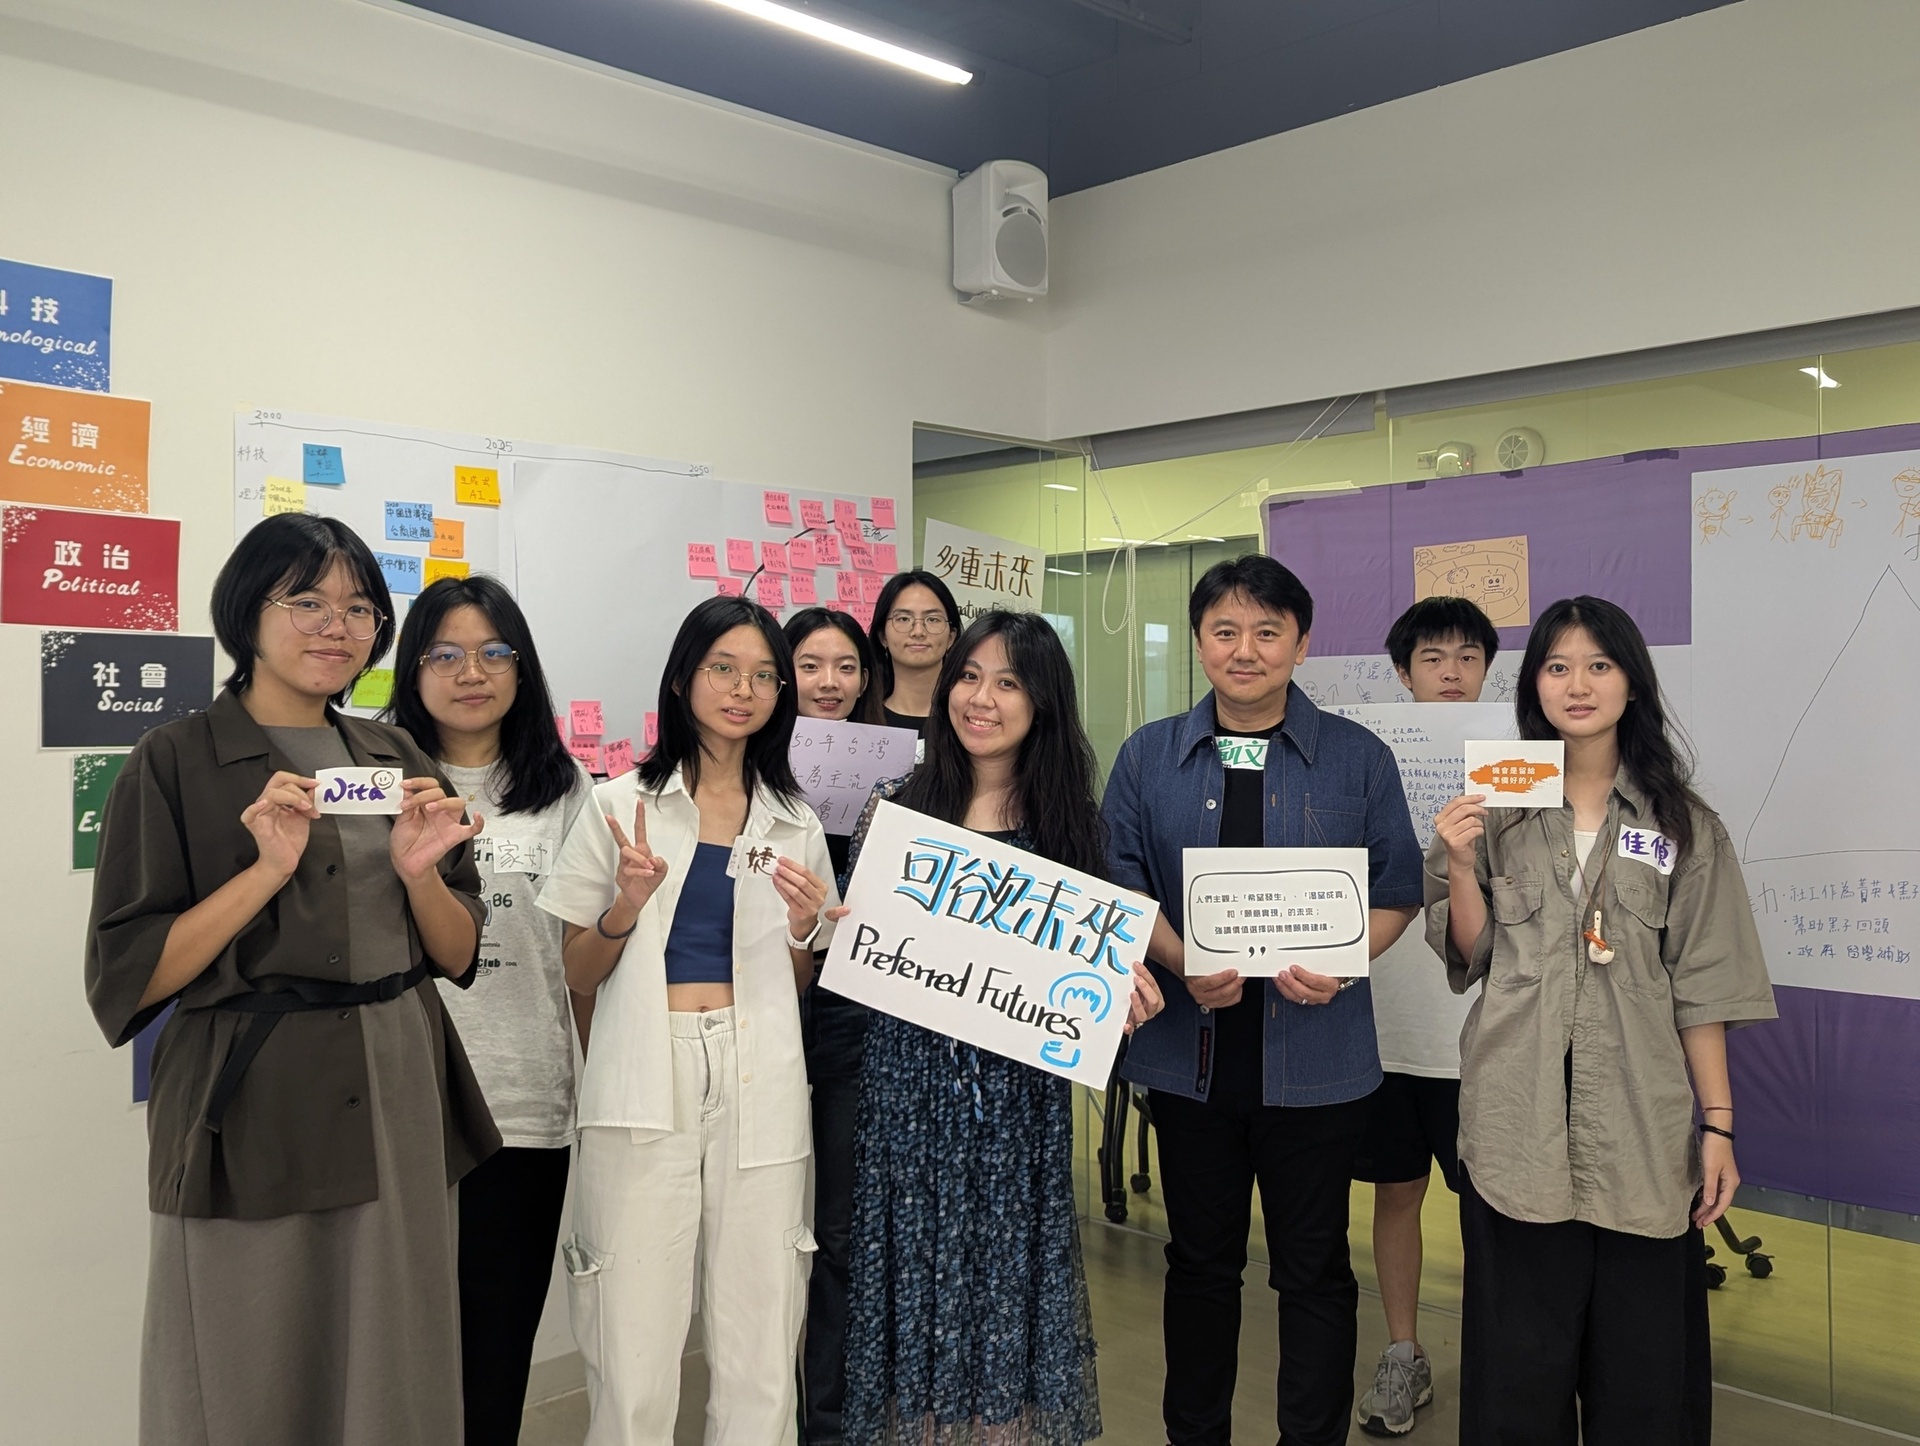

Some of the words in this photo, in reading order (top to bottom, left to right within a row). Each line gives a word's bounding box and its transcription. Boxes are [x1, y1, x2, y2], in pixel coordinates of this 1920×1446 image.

[254, 409, 282, 420] 2000
[21, 416, 99, 450] 經濟
[485, 437, 513, 453] 2025
[8, 443, 117, 476] Economic
[237, 445, 268, 463] 科技
[469, 490, 486, 500] AI
[54, 540, 130, 570] 政治
[42, 568, 141, 596] Political
[935, 545, 1034, 598] 多重未來
[93, 661, 167, 688] 社會
[97, 690, 165, 712] Social
[1492, 767, 1536, 775] 機會是留給
[1492, 776, 1536, 785] 準備好的人
[323, 777, 386, 803] Nita
[492, 893, 513, 908] 86
[894, 837, 1144, 976] 可欲未來
[477, 958, 501, 968] Club
[849, 923, 973, 998] Preferred
[977, 967, 1082, 1041] Futures
